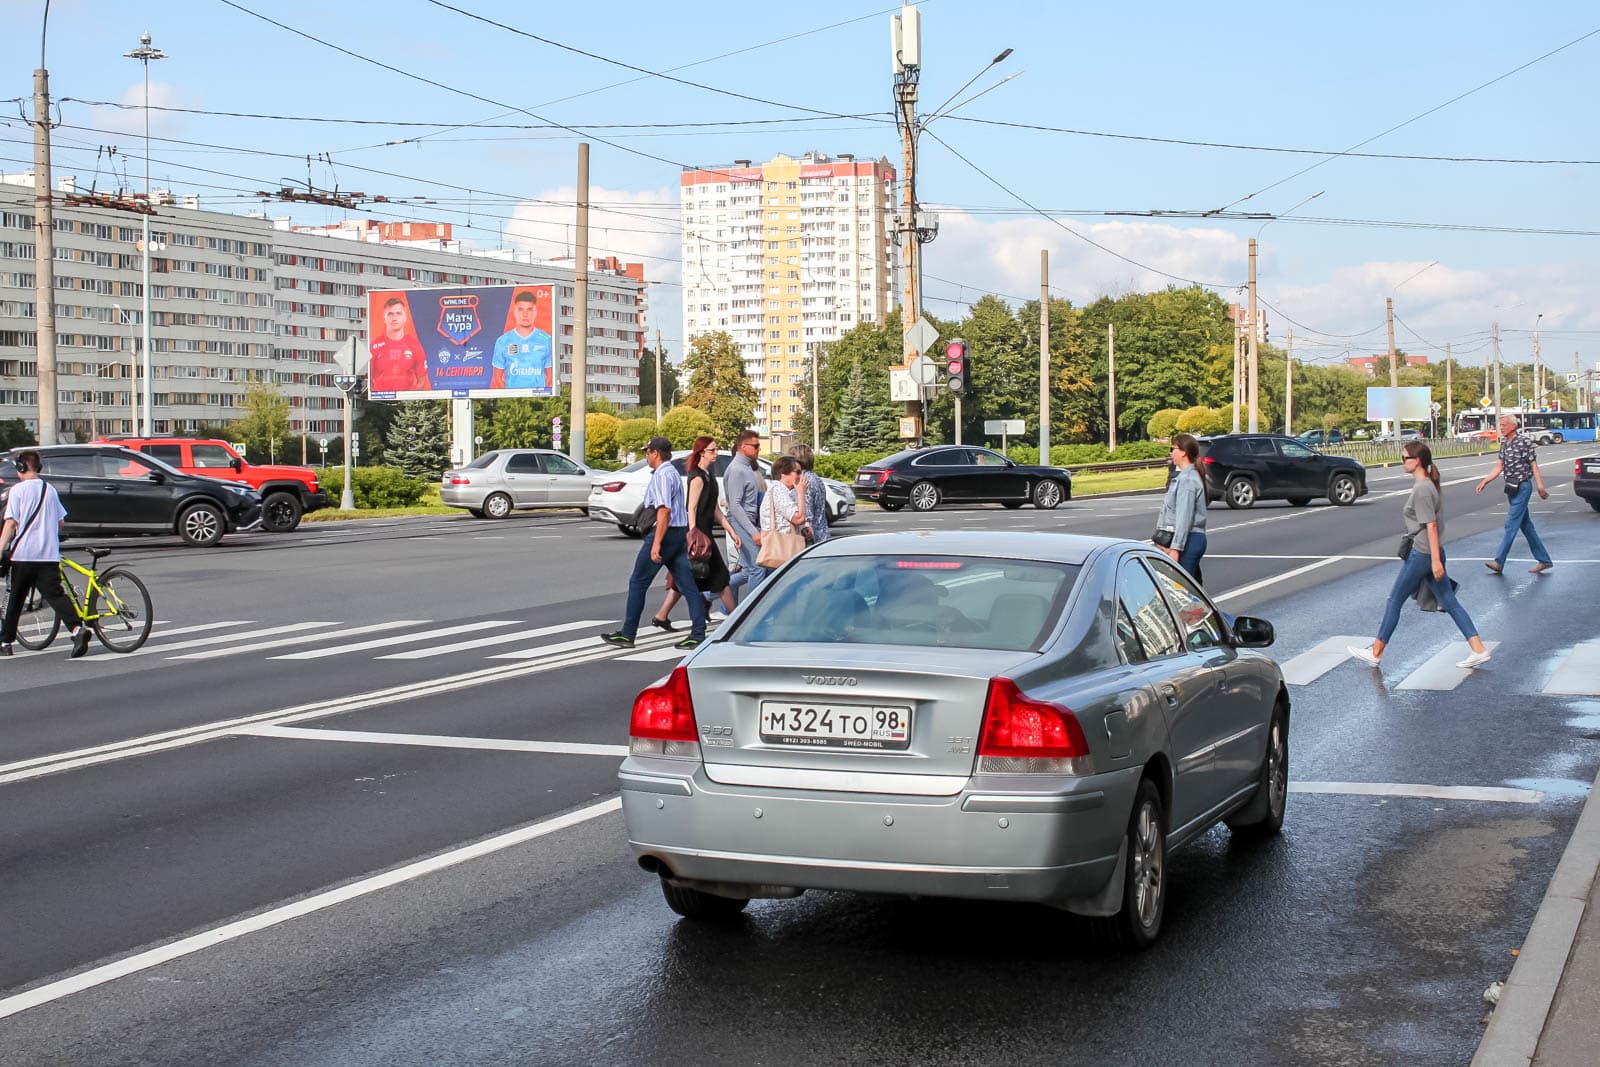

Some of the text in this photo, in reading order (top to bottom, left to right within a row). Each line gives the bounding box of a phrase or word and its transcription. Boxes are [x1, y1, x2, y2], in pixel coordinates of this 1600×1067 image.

[537, 289, 550, 298] 0+
[446, 312, 473, 323] Матч
[448, 322, 472, 333] тура
[445, 366, 484, 377] СЕНТЯБРЯ
[801, 675, 858, 687] VOLVO
[875, 710, 899, 730] 98
[873, 729, 891, 737] RUS
[843, 740, 883, 748] SWED-MOBIL
